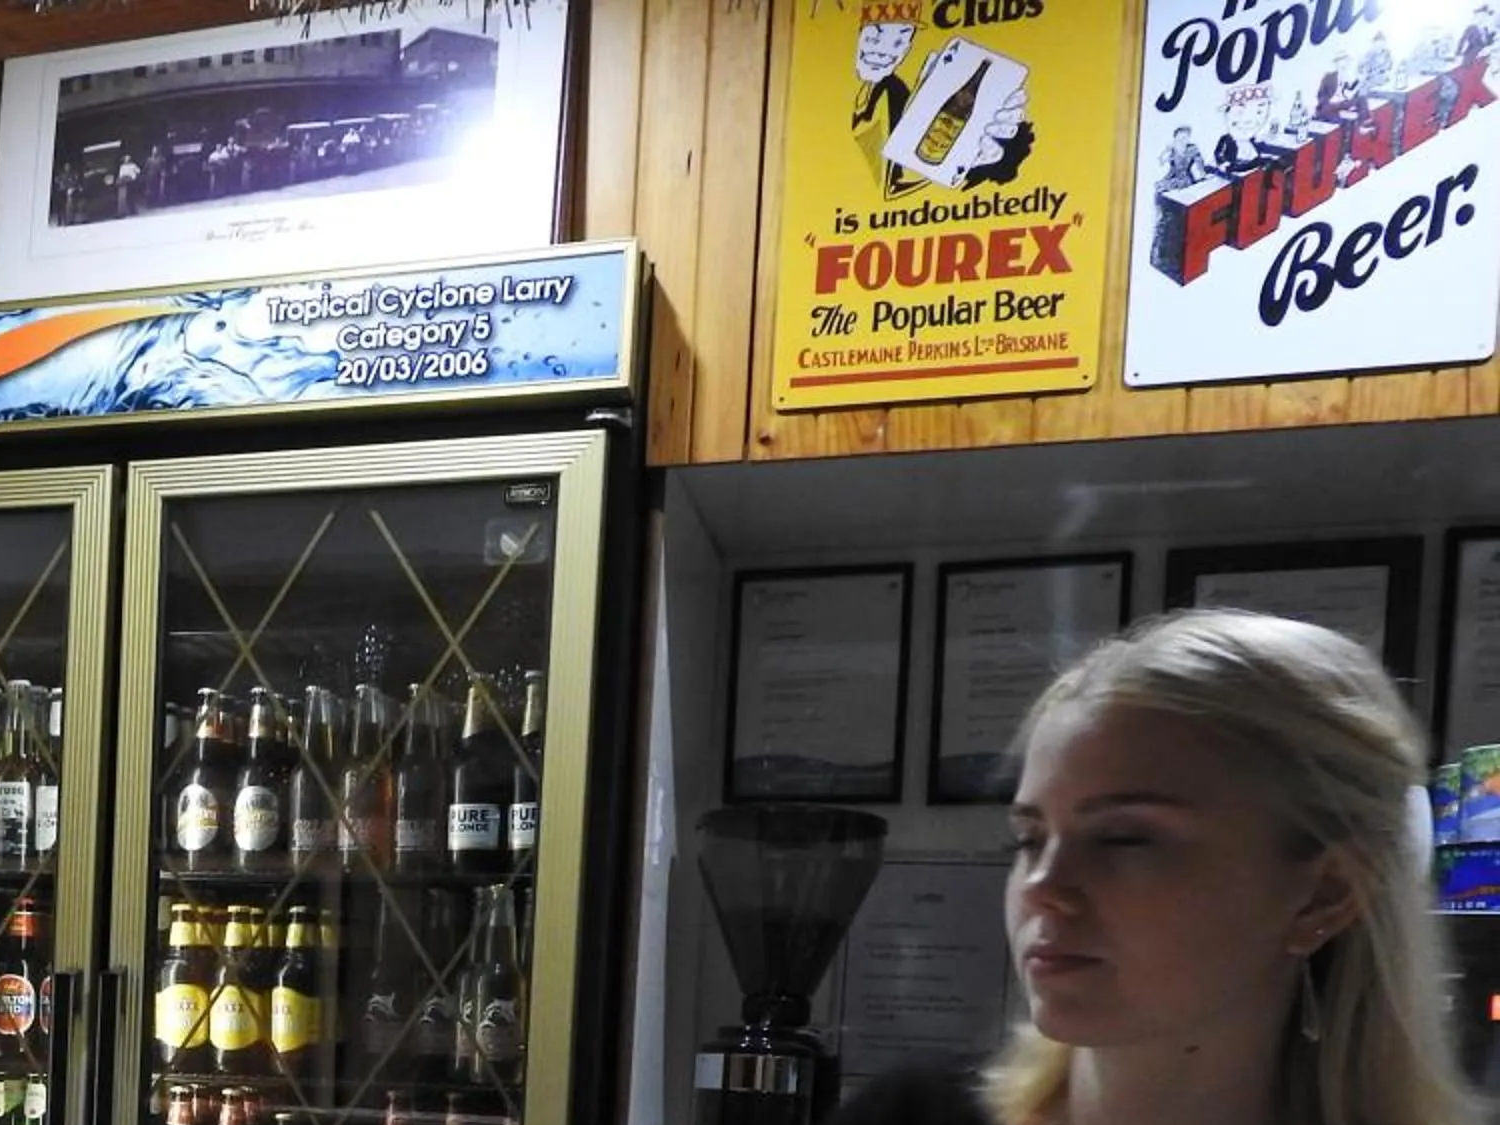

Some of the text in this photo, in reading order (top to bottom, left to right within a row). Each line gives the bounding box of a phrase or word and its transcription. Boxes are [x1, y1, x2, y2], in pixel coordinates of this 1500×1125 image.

[1155, 0, 1380, 112] Popu
[835, 187, 1067, 234] is undoubtedly
[1259, 163, 1478, 327] Beer.
[268, 275, 573, 325] Tropical Cyclone Larry
[811, 290, 1065, 338] The Popular Beer
[336, 314, 490, 350] Category 5
[336, 350, 488, 386] 20/03/2006
